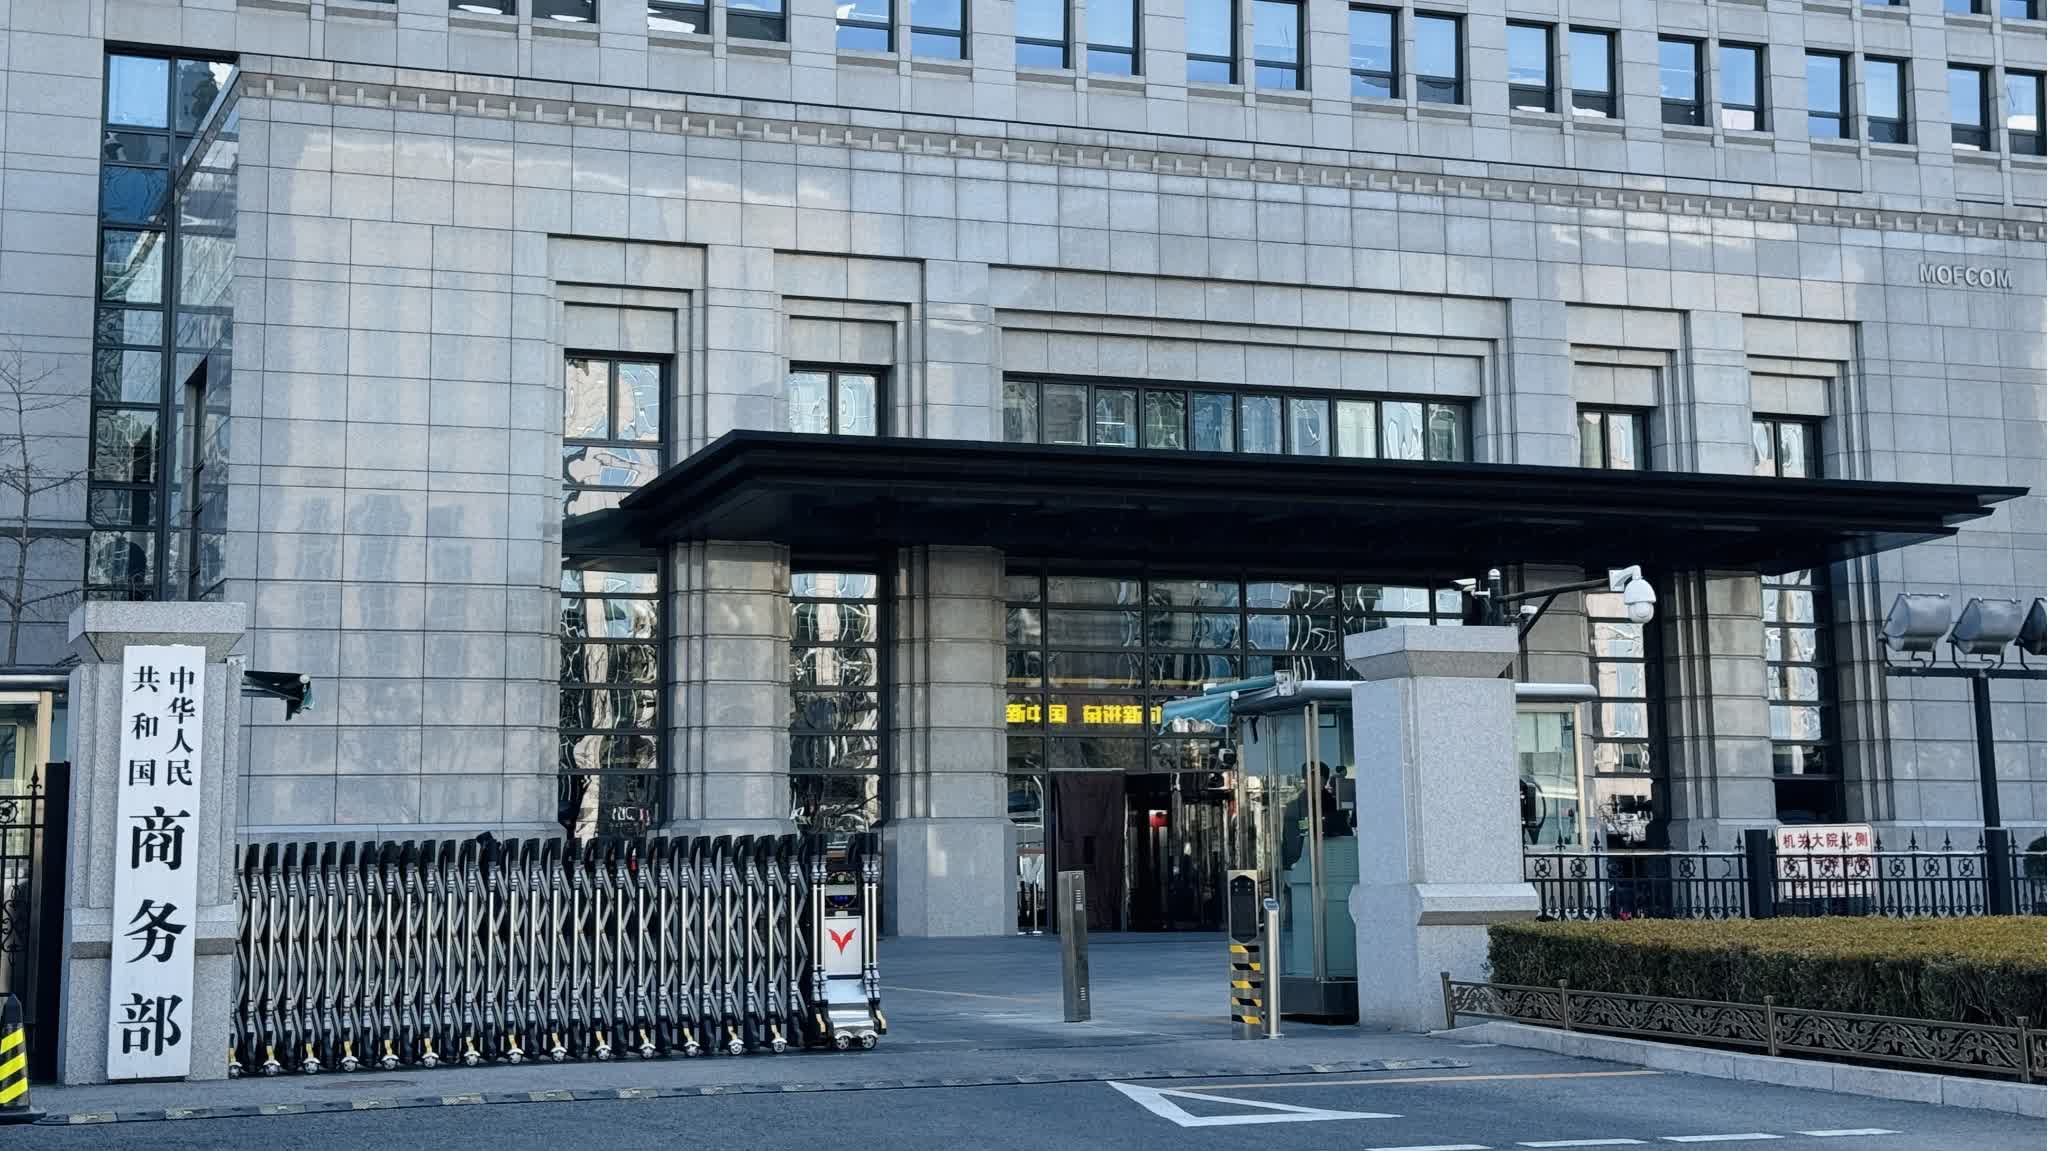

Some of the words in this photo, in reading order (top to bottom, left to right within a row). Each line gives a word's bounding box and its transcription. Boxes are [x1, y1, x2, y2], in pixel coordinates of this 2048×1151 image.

[1919, 264, 2012, 288] MOFCOM
[128, 666, 160, 786] 共和国
[167, 666, 195, 786] 中华人民
[1006, 704, 1067, 724] 新中国
[118, 806, 191, 1056] 商务部
